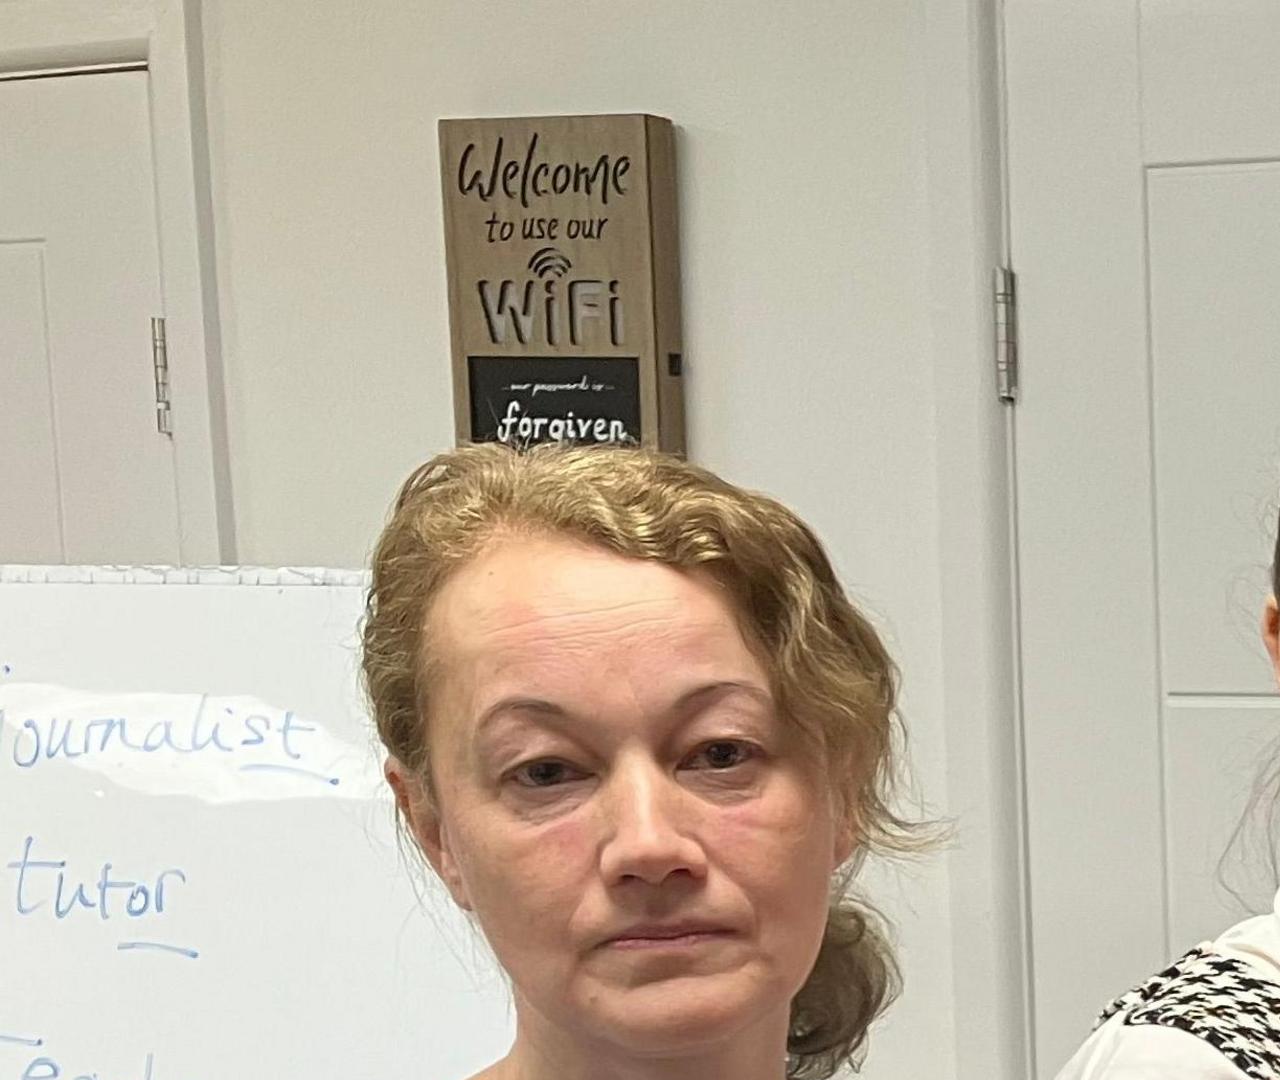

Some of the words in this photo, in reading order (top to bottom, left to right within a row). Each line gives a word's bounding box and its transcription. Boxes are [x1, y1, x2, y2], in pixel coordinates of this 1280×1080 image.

[457, 132, 630, 207] Welcome
[485, 212, 513, 243] to
[522, 218, 558, 240] use
[566, 217, 609, 240] our
[476, 279, 623, 347] WiFi
[0, 693, 315, 768] ournalist
[9, 836, 186, 919] tutor
